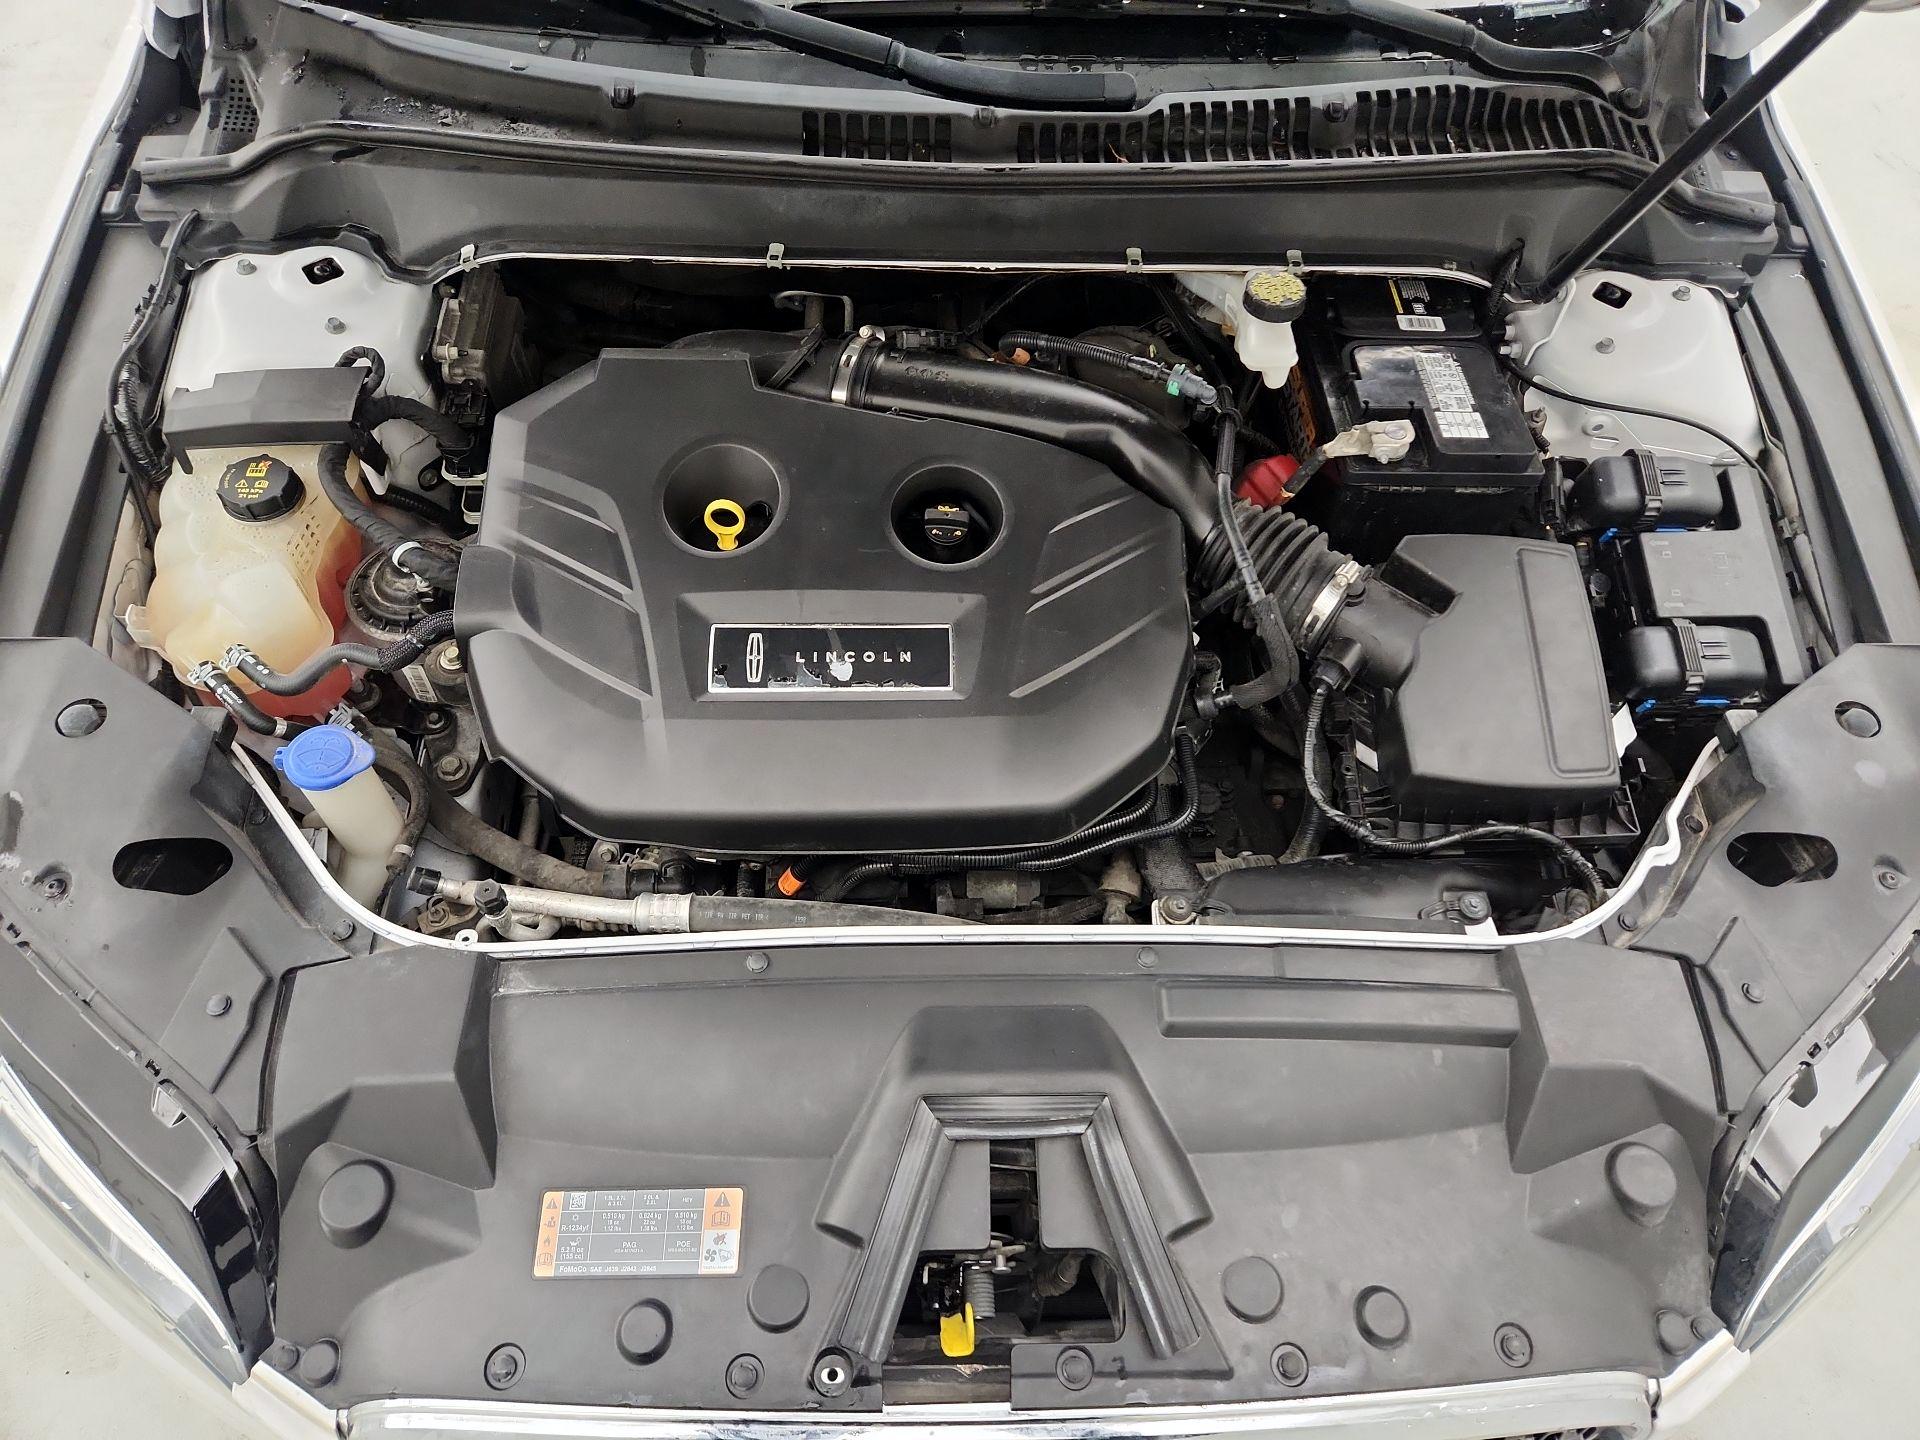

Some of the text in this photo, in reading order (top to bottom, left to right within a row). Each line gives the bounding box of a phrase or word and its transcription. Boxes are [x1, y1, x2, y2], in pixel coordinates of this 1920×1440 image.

[796, 651, 912, 663] LINCOLN
[618, 1212, 625, 1220] kg
[654, 1212, 662, 1220] kg
[690, 1211, 697, 1220] kg
[561, 1224, 590, 1232] R-1234yf
